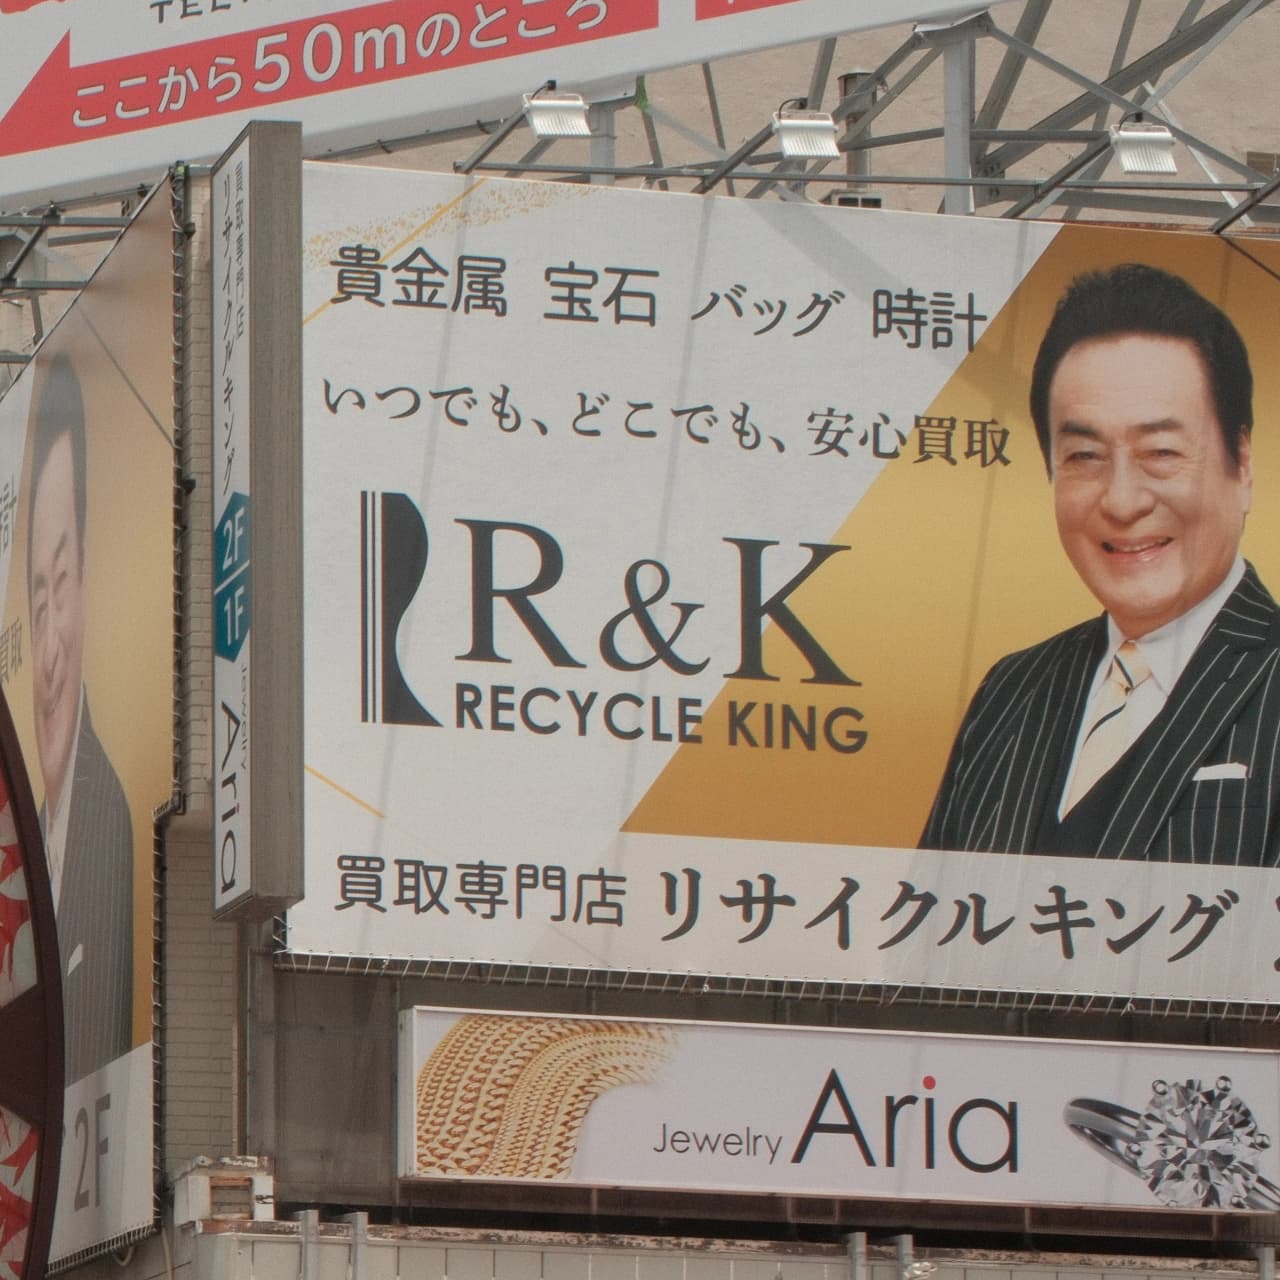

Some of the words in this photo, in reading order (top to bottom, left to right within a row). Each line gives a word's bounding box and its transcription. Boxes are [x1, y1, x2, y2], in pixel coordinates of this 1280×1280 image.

[223, 174, 235, 497] リサイクルキング
[331, 244, 507, 319] 貴金属
[544, 261, 661, 328] 宝石
[690, 287, 842, 342] バッグ
[871, 289, 989, 353] 時計
[322, 376, 1012, 469] いつでも、どこでも、安心買取
[223, 507, 244, 571] 2F
[223, 584, 244, 646] 1F
[453, 516, 864, 686] R&K
[456, 684, 704, 745] RECYCLE
[727, 701, 869, 756] KING
[221, 700, 241, 894] Aria
[333, 853, 628, 930] 買取専門店
[654, 866, 1239, 964] リサイクルキング
[74, 1093, 111, 1212] 2F
[652, 1122, 784, 1166] Jewelry
[790, 1068, 1021, 1175] Aria
